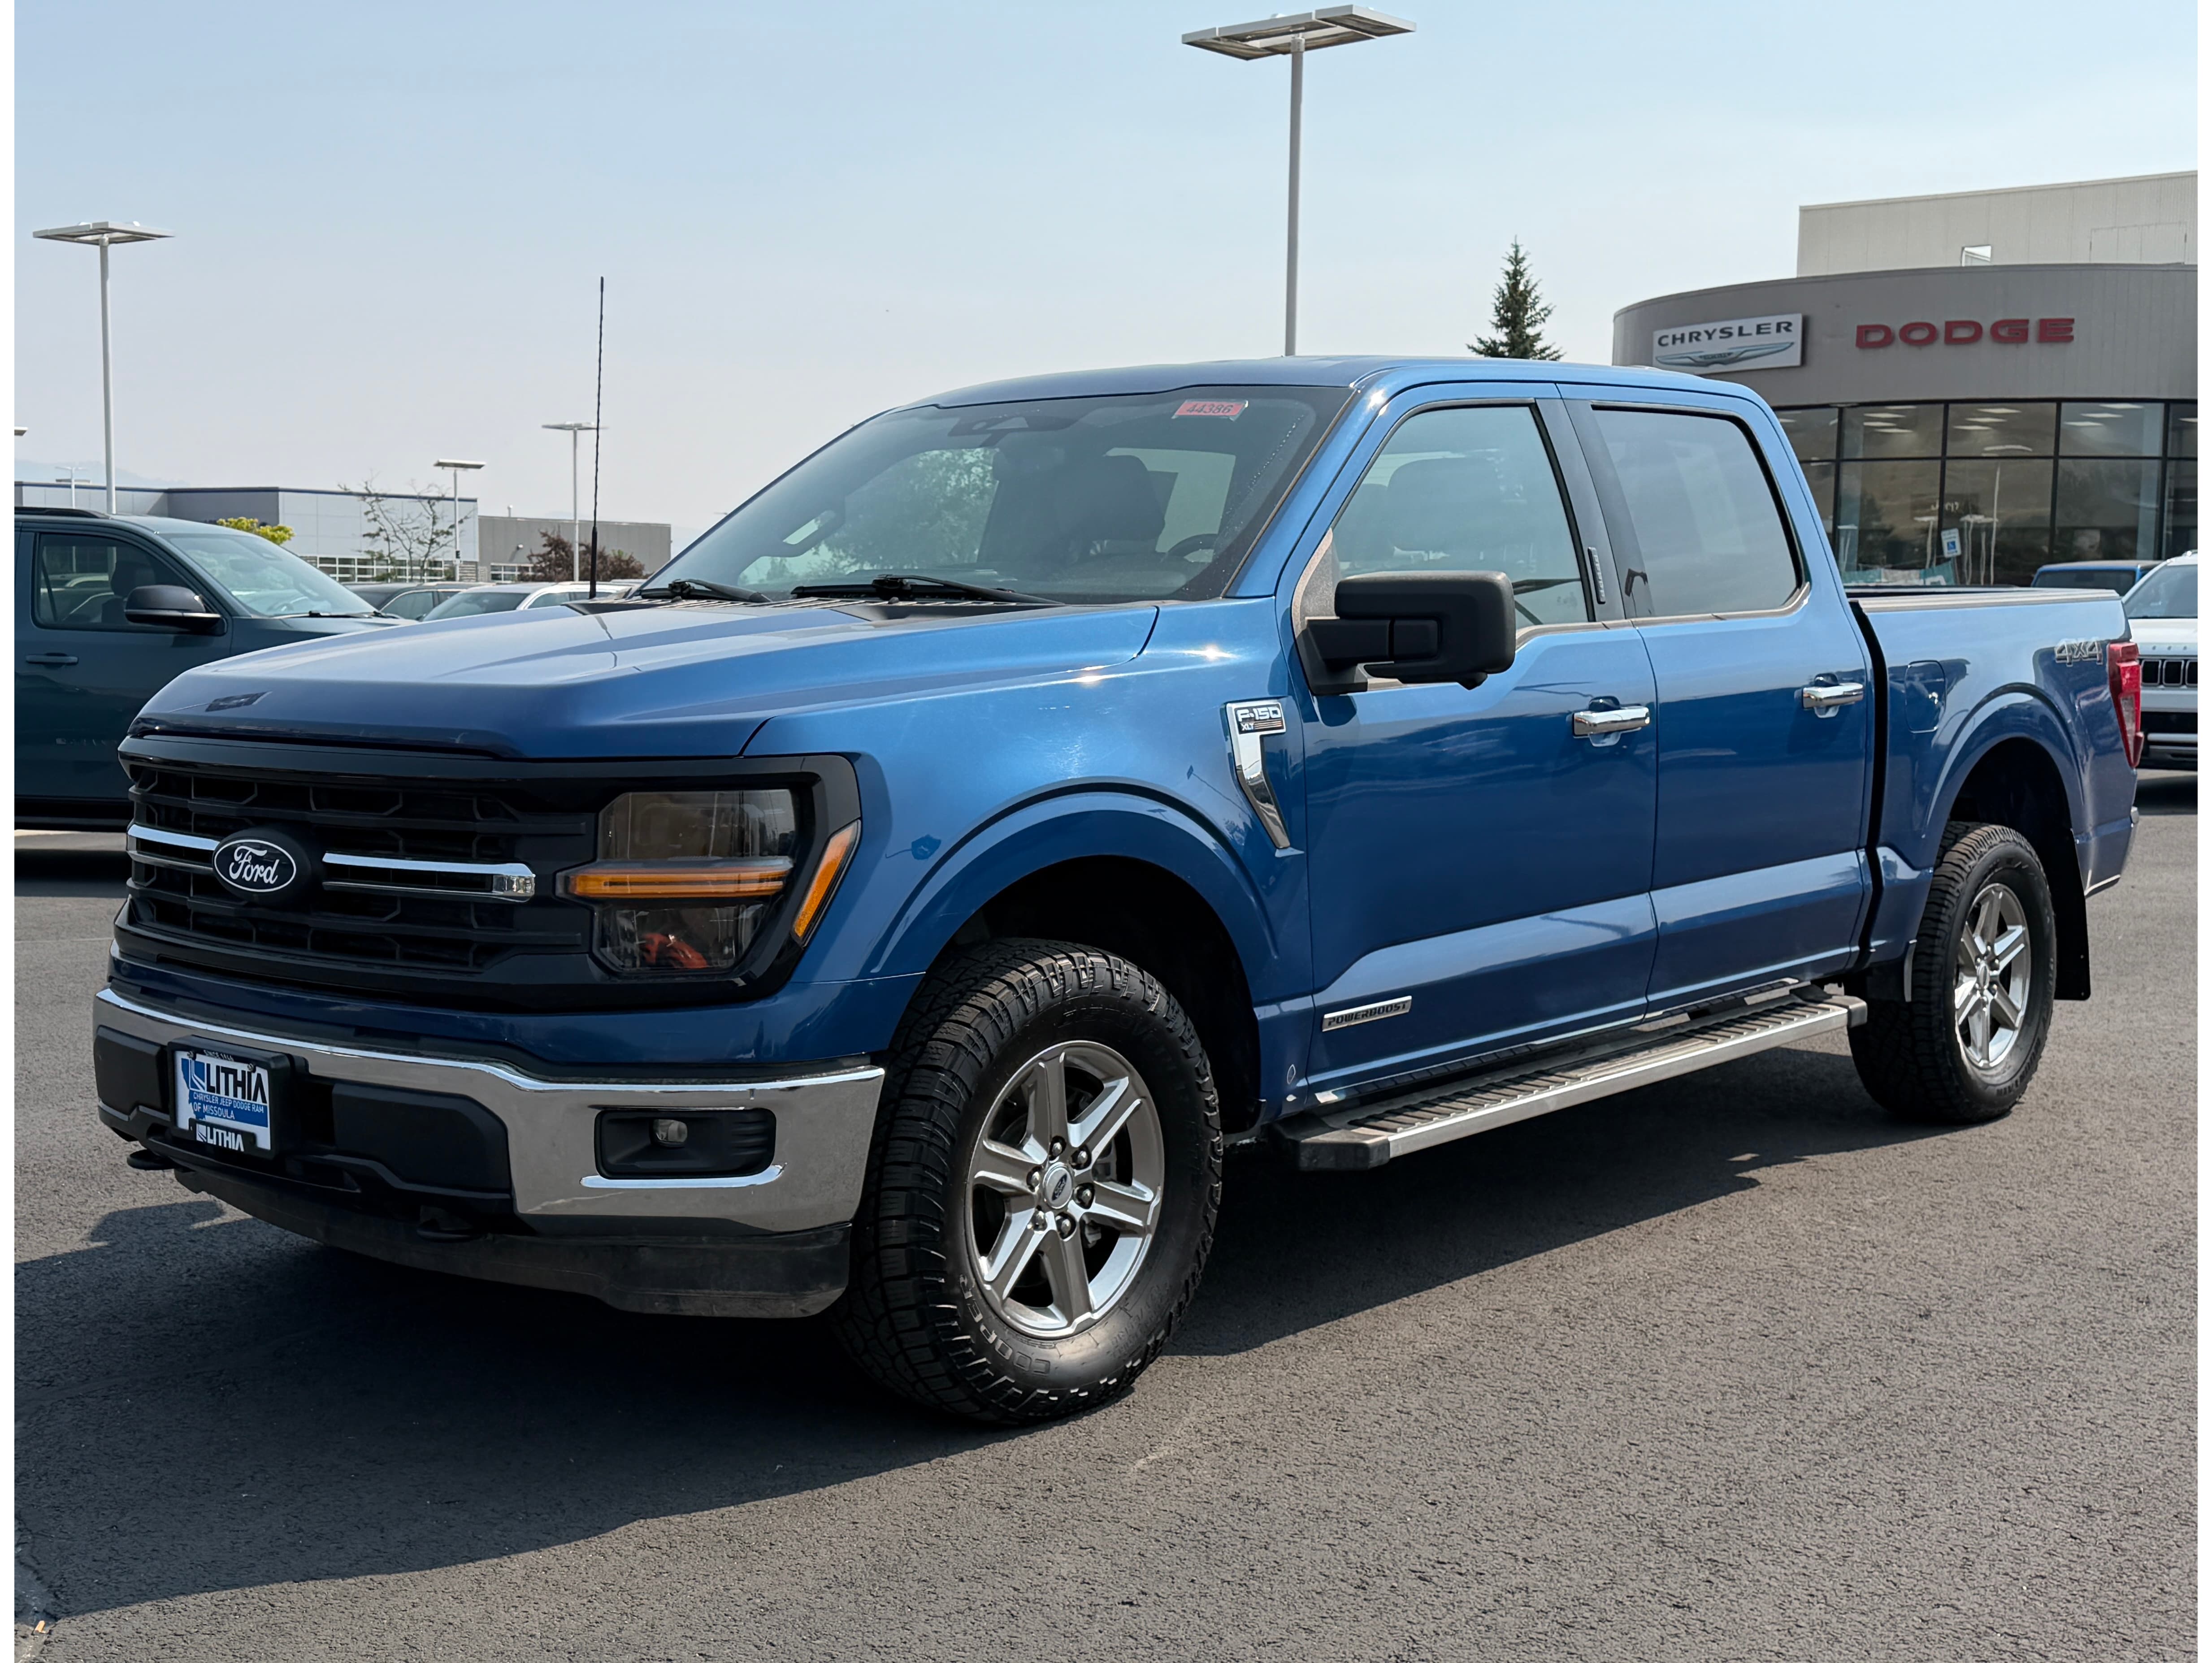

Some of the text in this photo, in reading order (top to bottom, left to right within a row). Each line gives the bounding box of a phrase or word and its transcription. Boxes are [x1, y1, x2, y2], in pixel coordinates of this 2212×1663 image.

[1657, 321, 1793, 347] CHRYSLER
[1855, 318, 2075, 349] DODGE
[1187, 403, 1233, 414] 44386
[229, 845, 280, 884] Ford
[1327, 1001, 1408, 1026] POWERBOOST
[206, 1063, 268, 1104] LITHIA
[193, 1092, 264, 1113] CHRYSLER JEEP DODGE RAM
[193, 1102, 235, 1120] OF MISSOULA
[207, 1126, 244, 1152] LITHIA
[959, 1274, 1051, 1377] COOPER
